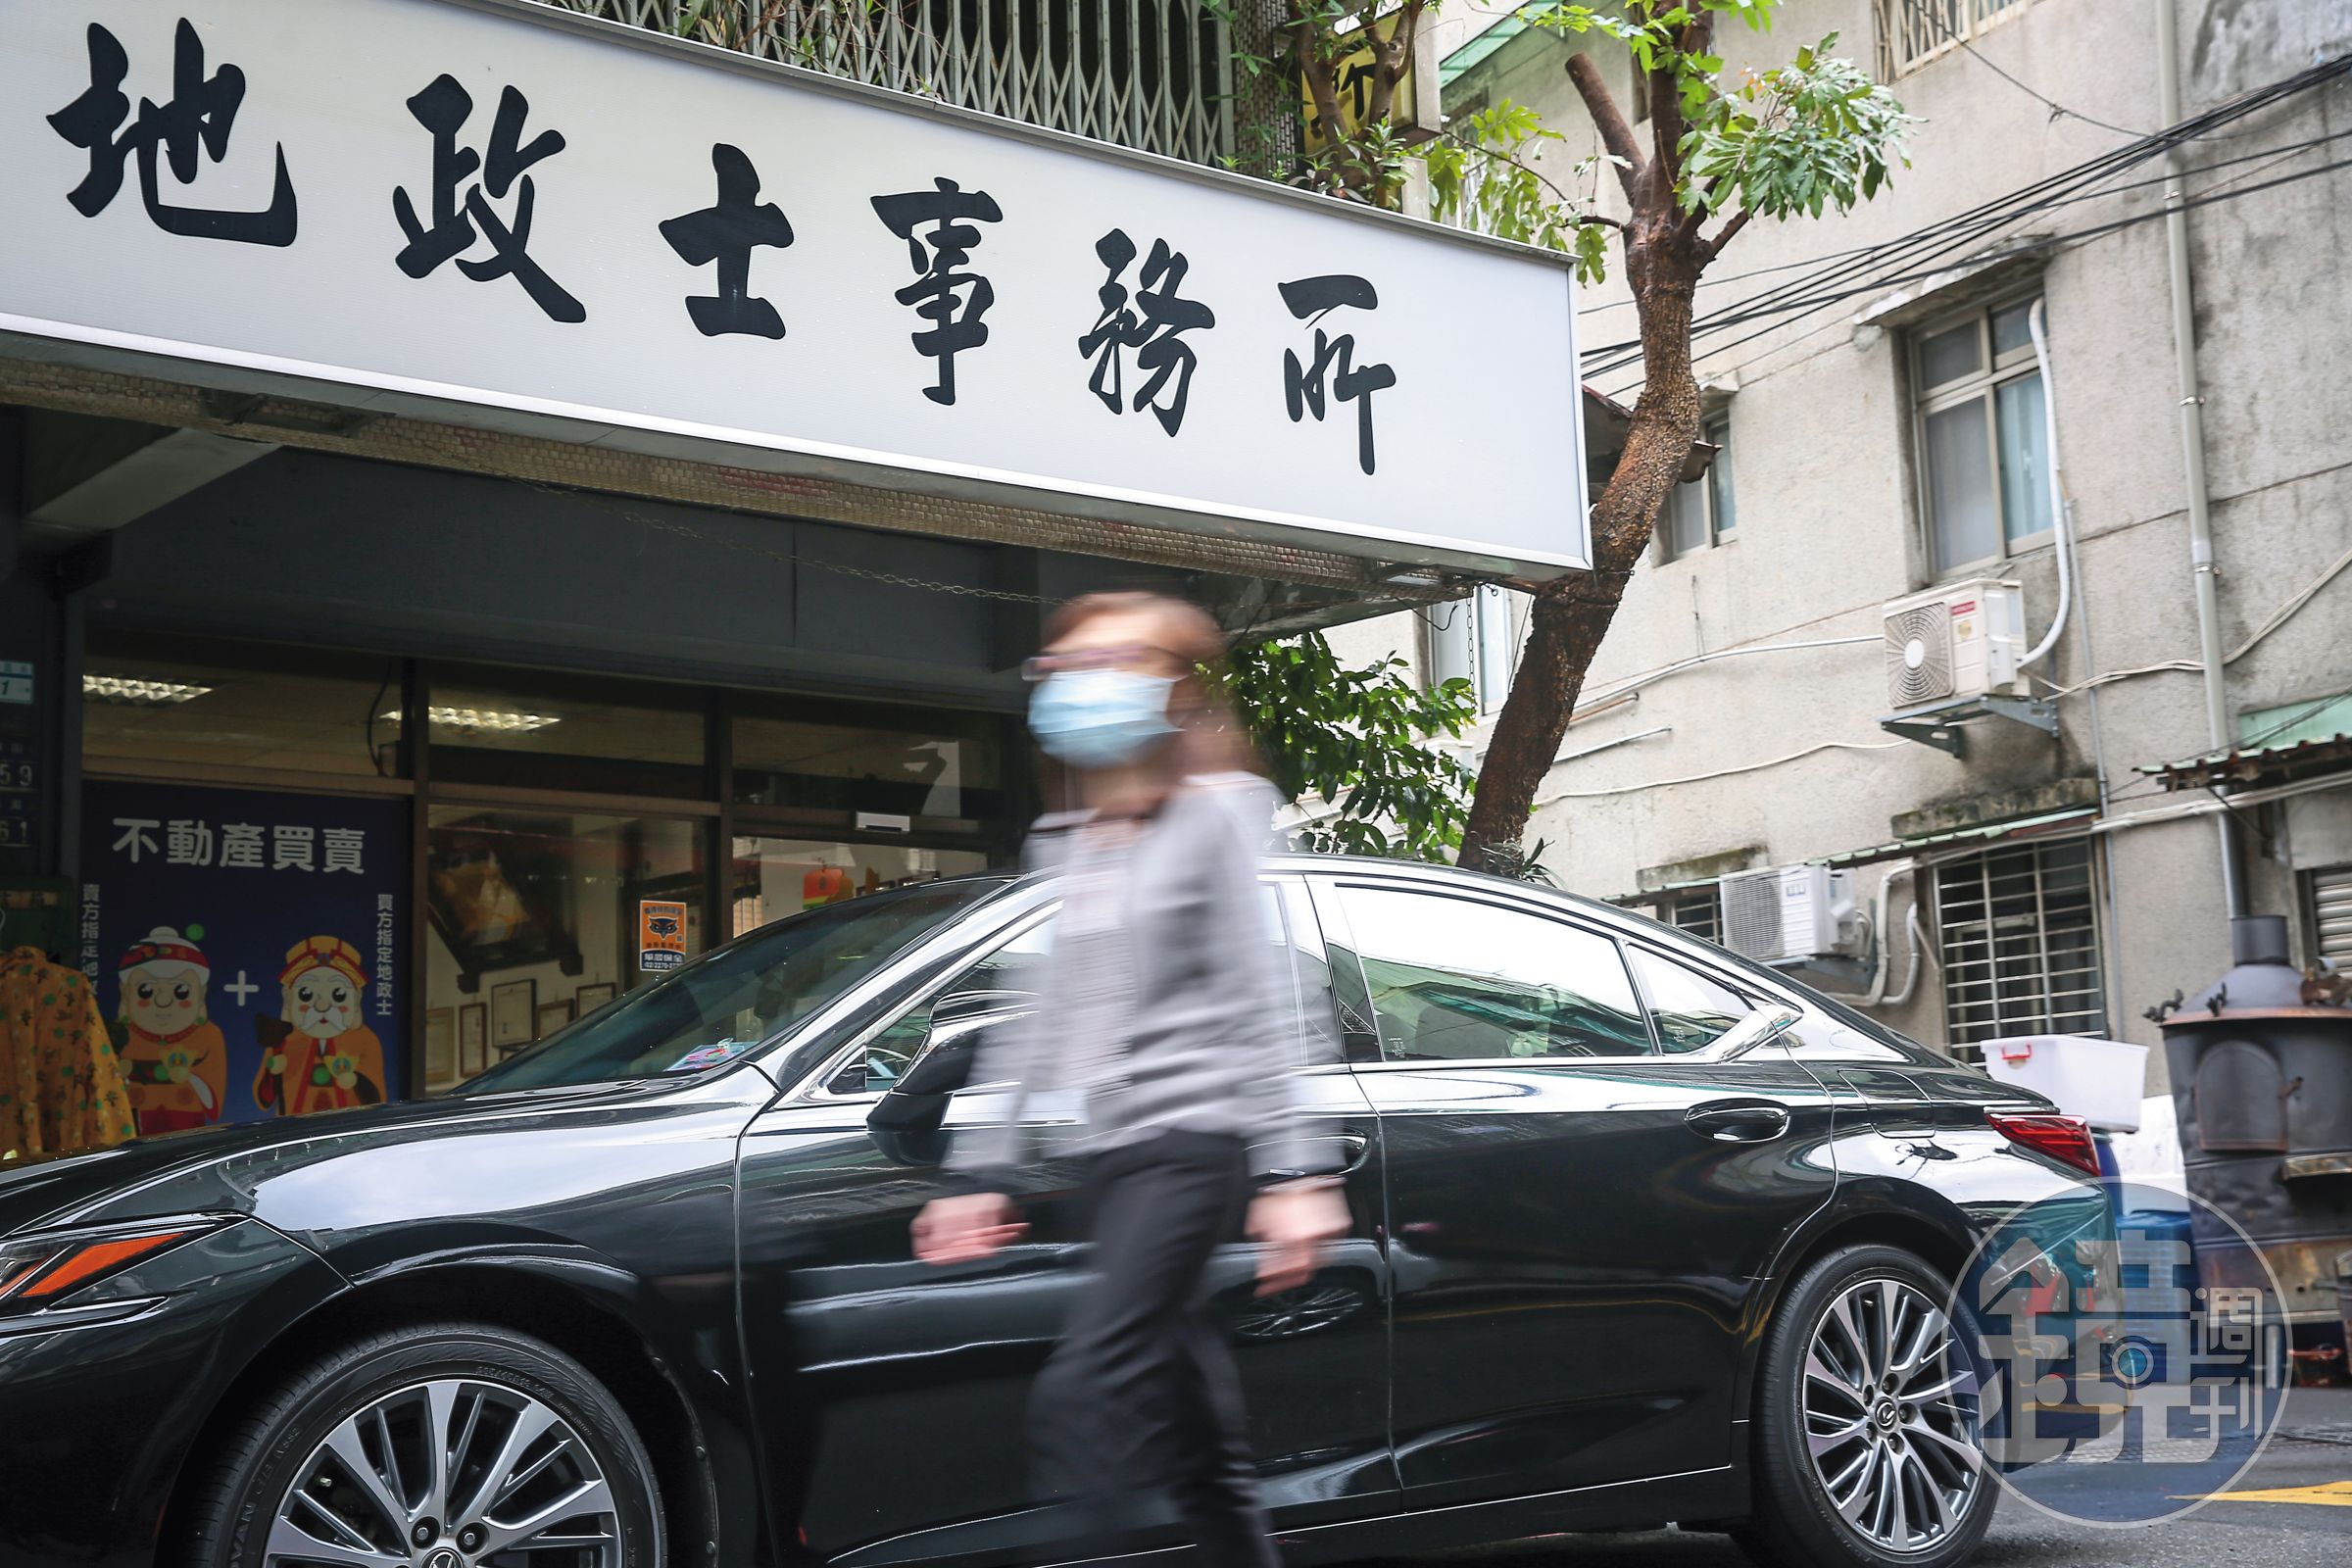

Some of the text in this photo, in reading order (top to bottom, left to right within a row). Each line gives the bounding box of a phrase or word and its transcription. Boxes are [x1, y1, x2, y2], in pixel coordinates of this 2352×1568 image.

[46, 17, 1396, 476] 地政士事務所
[112, 816, 367, 875] 不動產買賣
[376, 893, 394, 1016] 買方指定地政士
